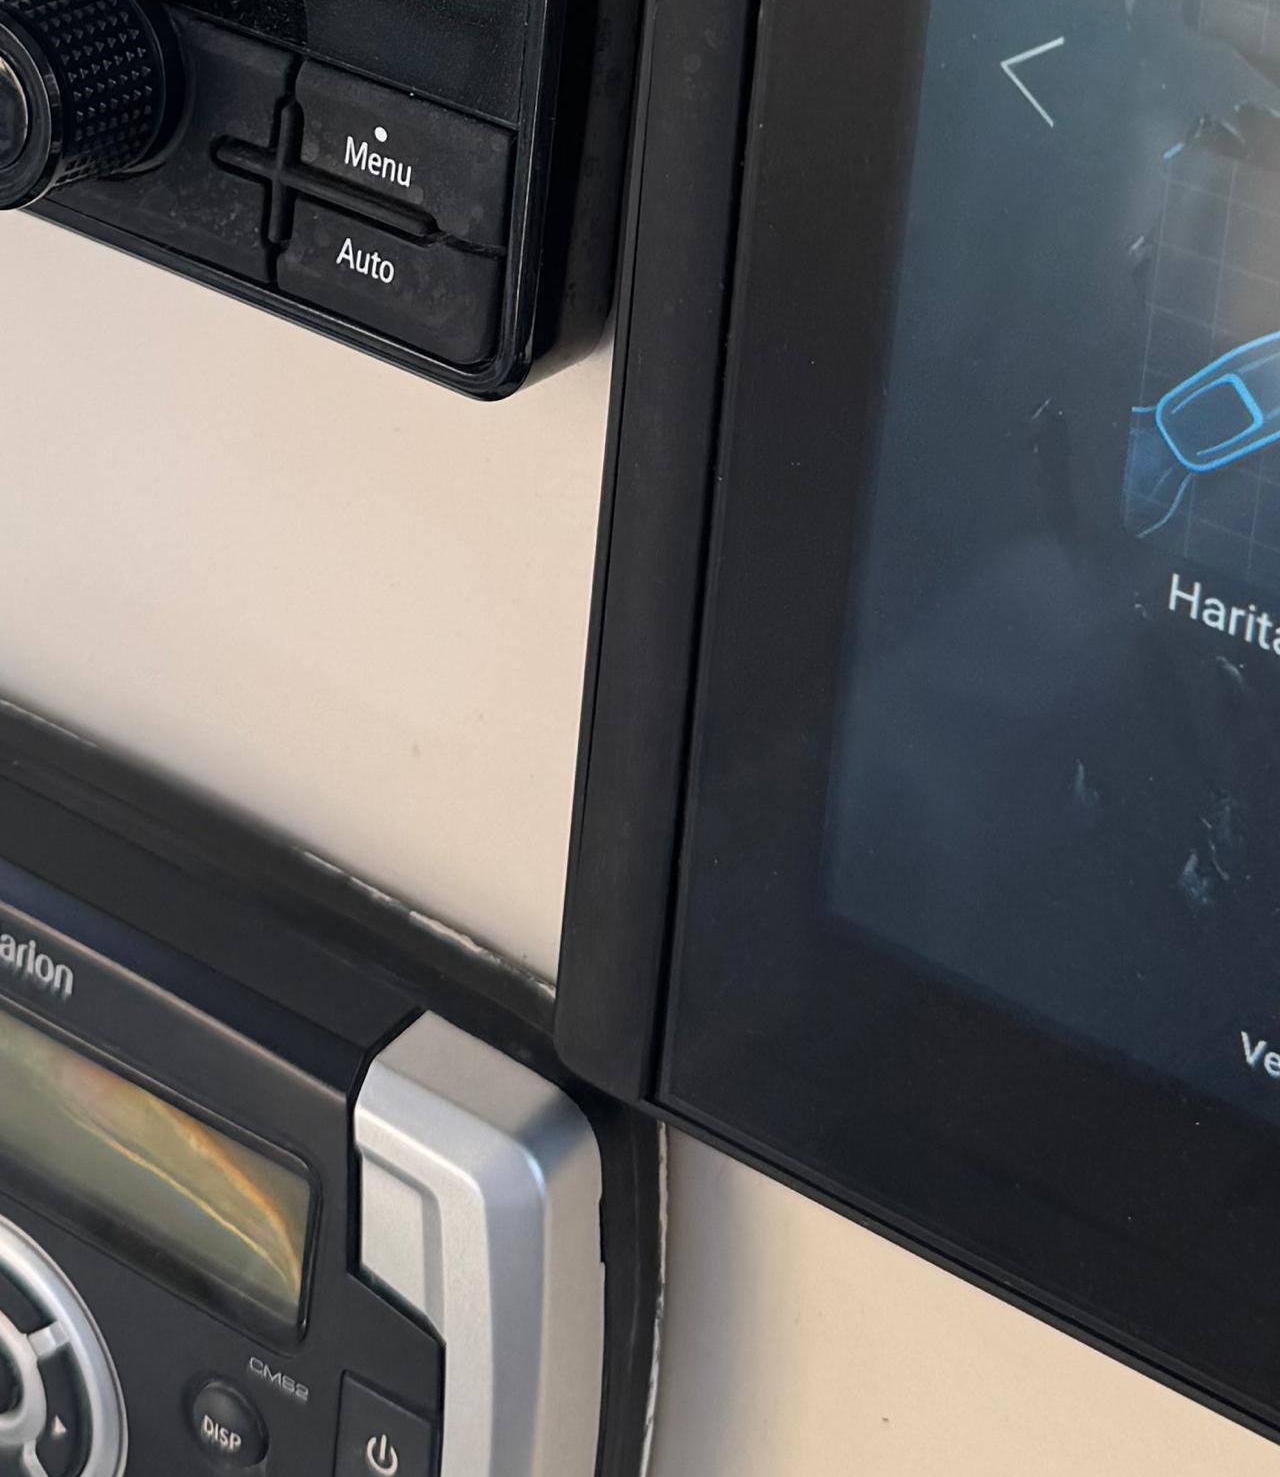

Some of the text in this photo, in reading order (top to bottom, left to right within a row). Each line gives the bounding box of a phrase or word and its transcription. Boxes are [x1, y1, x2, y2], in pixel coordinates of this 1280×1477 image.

[344, 135, 413, 188] Menu
[335, 237, 396, 284] Auto
[201, 1413, 242, 1449] DISP
